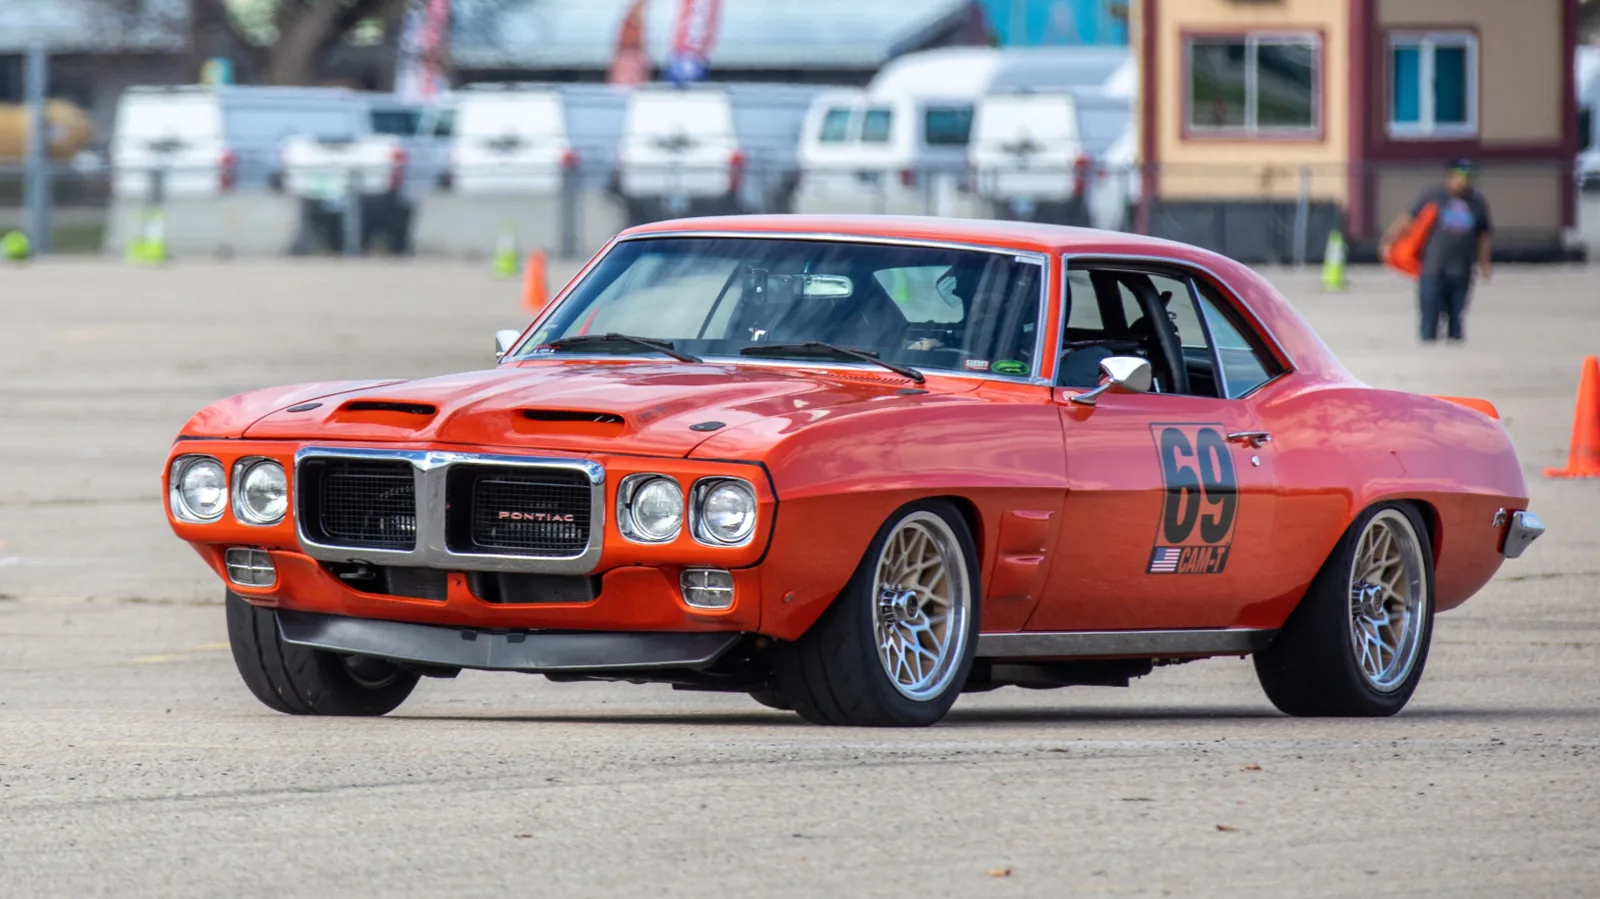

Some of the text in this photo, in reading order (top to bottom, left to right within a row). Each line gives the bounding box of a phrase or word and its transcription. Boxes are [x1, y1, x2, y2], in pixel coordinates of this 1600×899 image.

[1161, 427, 1237, 543] 69
[498, 511, 574, 521] PONTIAC
[1178, 547, 1226, 574] CAM-T
